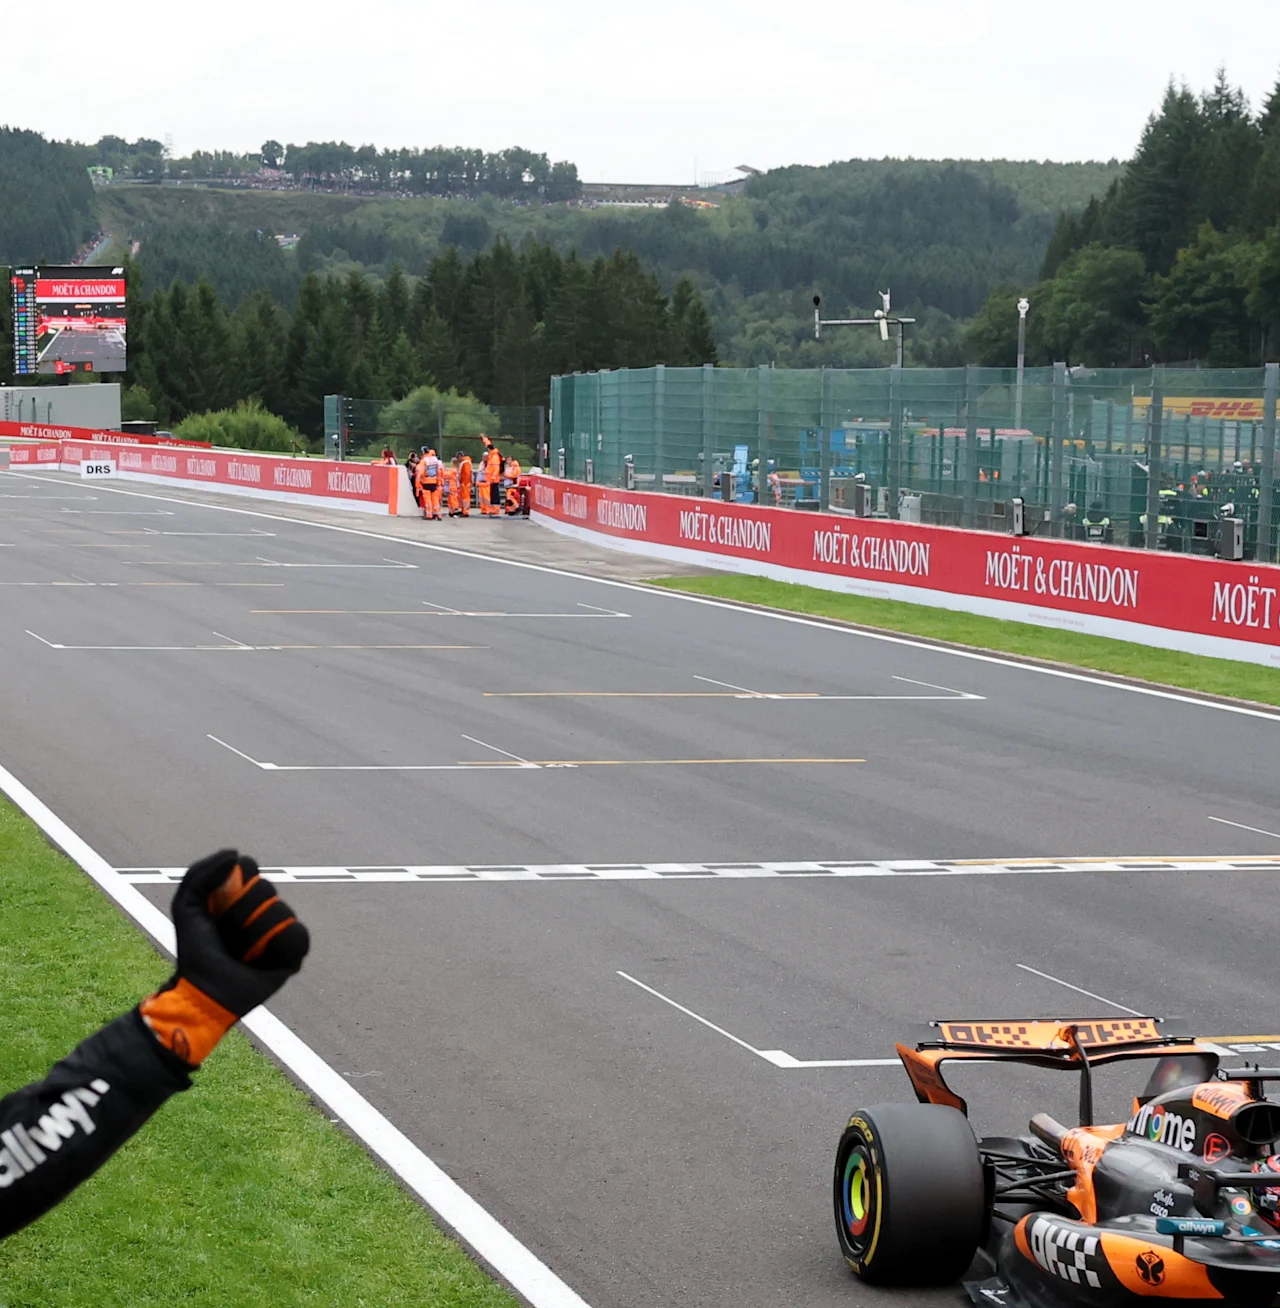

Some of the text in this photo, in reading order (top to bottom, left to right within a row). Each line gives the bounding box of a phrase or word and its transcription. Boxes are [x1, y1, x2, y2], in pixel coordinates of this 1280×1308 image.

[1190, 402, 1260, 417] DHL
[87, 465, 110, 474] DRS
[680, 506, 771, 552] MOËT & CHANDON
[813, 525, 930, 577] MOËT & CHANDON
[985, 545, 1138, 607] MOËT & CHANDON
[1211, 575, 1278, 629] MOËT
[1195, 1087, 1237, 1114] allwyn
[1127, 1104, 1196, 1152] hrome
[1150, 1203, 1169, 1217] CISCO
[1178, 1221, 1216, 1234] allwyn
[1031, 1217, 1101, 1288] OKX
